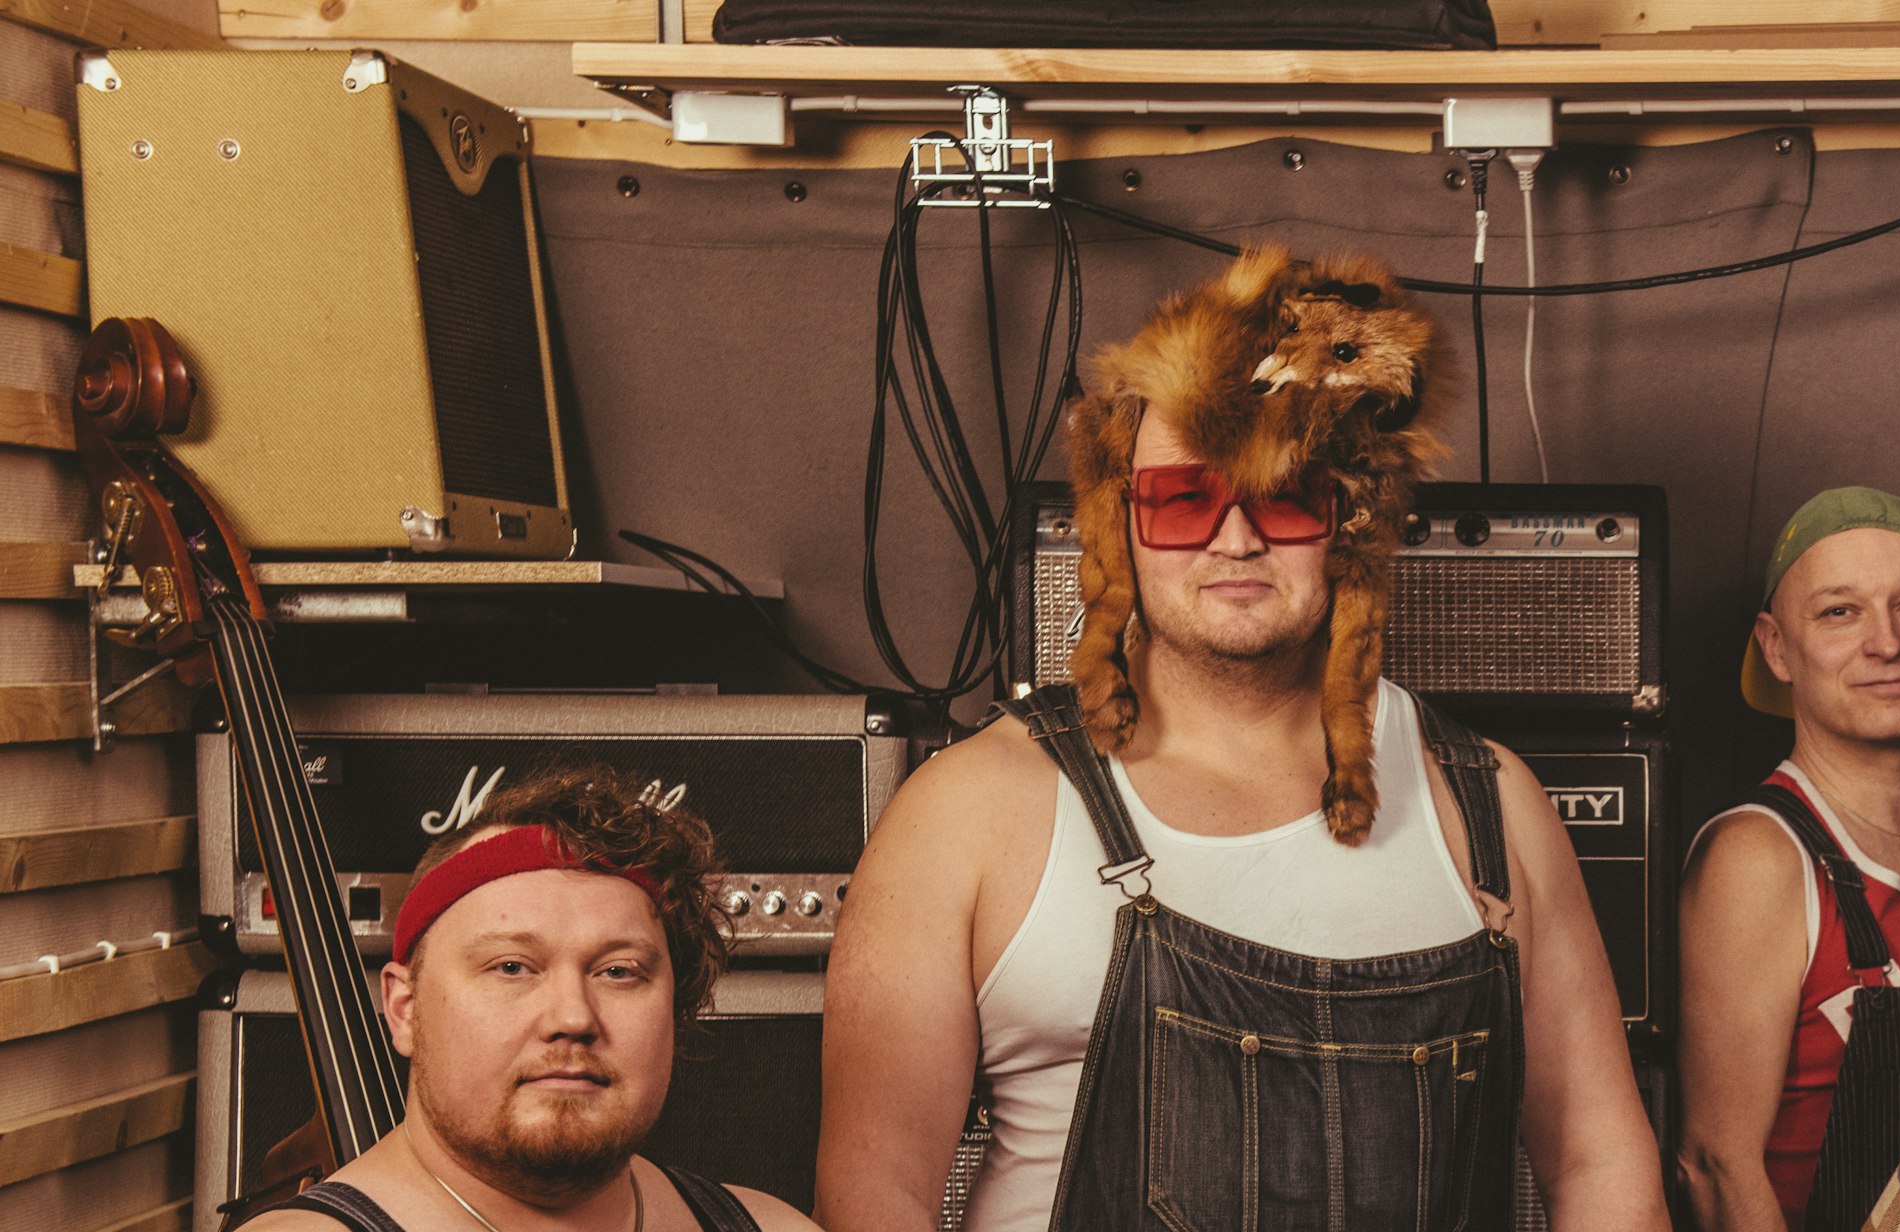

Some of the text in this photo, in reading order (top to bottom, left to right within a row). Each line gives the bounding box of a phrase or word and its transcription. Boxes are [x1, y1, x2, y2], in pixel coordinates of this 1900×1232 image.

[1510, 514, 1587, 529] BASSMAN
[1532, 530, 1566, 548] 70
[1551, 794, 1614, 818] ITY
